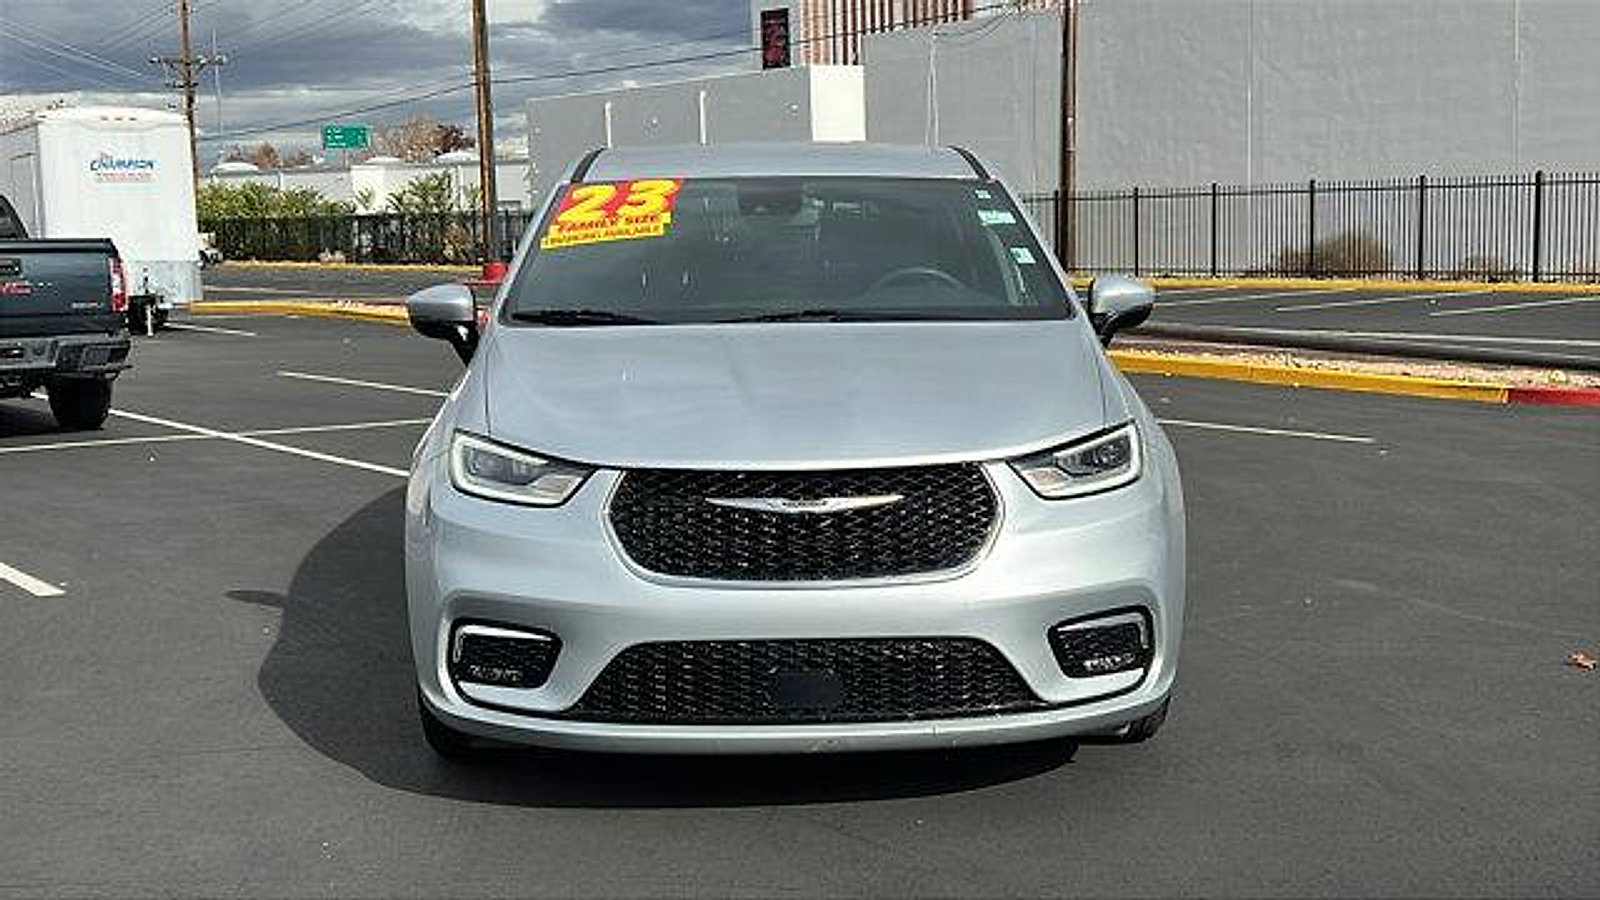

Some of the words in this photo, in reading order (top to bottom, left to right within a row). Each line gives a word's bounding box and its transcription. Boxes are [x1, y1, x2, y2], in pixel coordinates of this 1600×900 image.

[558, 180, 676, 222] 23
[557, 217, 618, 234] FAMILY
[624, 213, 660, 226] SIZE
